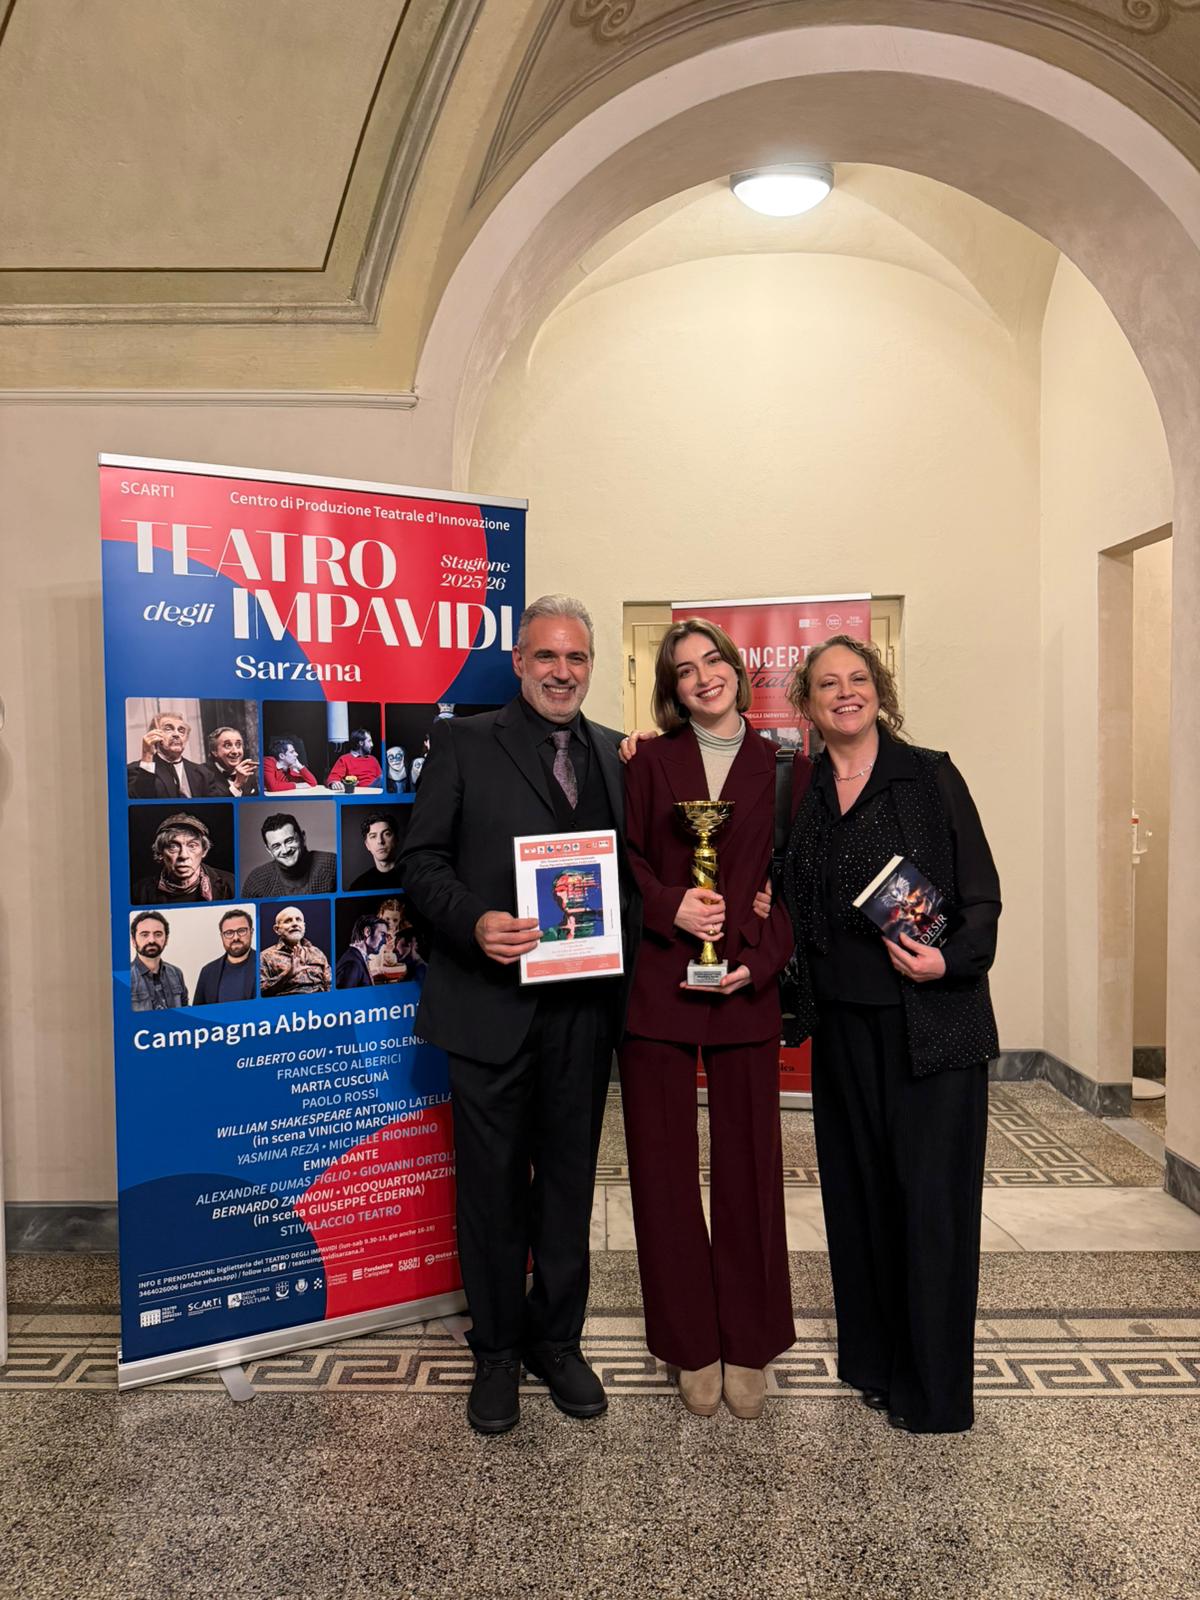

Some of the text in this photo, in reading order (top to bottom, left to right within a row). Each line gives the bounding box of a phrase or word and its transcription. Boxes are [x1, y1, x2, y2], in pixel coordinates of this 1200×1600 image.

[120, 481, 174, 498] SCARTI
[230, 491, 277, 508] Centro
[280, 496, 293, 510] di
[296, 497, 371, 517] Produzione
[374, 505, 424, 523] Teatrale
[120, 519, 397, 590] TEATRO
[440, 554, 510, 573] Stagione
[143, 587, 512, 651] degli IMPAVIDI
[235, 654, 362, 682] Sarzana
[737, 645, 811, 669] ONCERT
[134, 1000, 420, 1050] Campagna Abbonamen
[236, 1035, 428, 1069] GILBERTO GOVI TULLIO SOLENG
[277, 1053, 401, 1080] FRANCESCO ALBERICI
[291, 1069, 389, 1095] MARTA CUSCUNÀ
[302, 1088, 378, 1109] PAOLO ROSSI
[217, 1121, 267, 1138] WILLIAM
[270, 1108, 352, 1130] SHAKESPEARE
[355, 1100, 406, 1117] ANTONIO
[253, 1109, 424, 1148] (in scena VINICIO MARCHIONI)
[237, 1122, 438, 1165] YASMINA REZA MICHELE RIONDINO
[303, 1148, 379, 1171] EMMA DANTE
[195, 1183, 267, 1206] ALEXANDRE
[270, 1176, 311, 1193] DUMAS
[313, 1169, 351, 1185] FIGLIO
[360, 1158, 414, 1177] GIOVANNI
[212, 1166, 456, 1220] BERNARDO ZANNONI VICOQUARTOMAZZIN
[254, 1184, 425, 1228] (in scena GIUSEPPE CEDERNA)
[280, 1204, 402, 1237] STIVALACCIO TEATRO
[138, 1280, 156, 1289] INFO
[216, 1262, 252, 1274] biglietteria
[253, 1259, 264, 1267] del
[264, 1254, 290, 1264] TEATRO
[291, 1251, 310, 1259] DEGLI
[242, 1268, 262, 1277] follow
[242, 1296, 270, 1306] CULTURA
